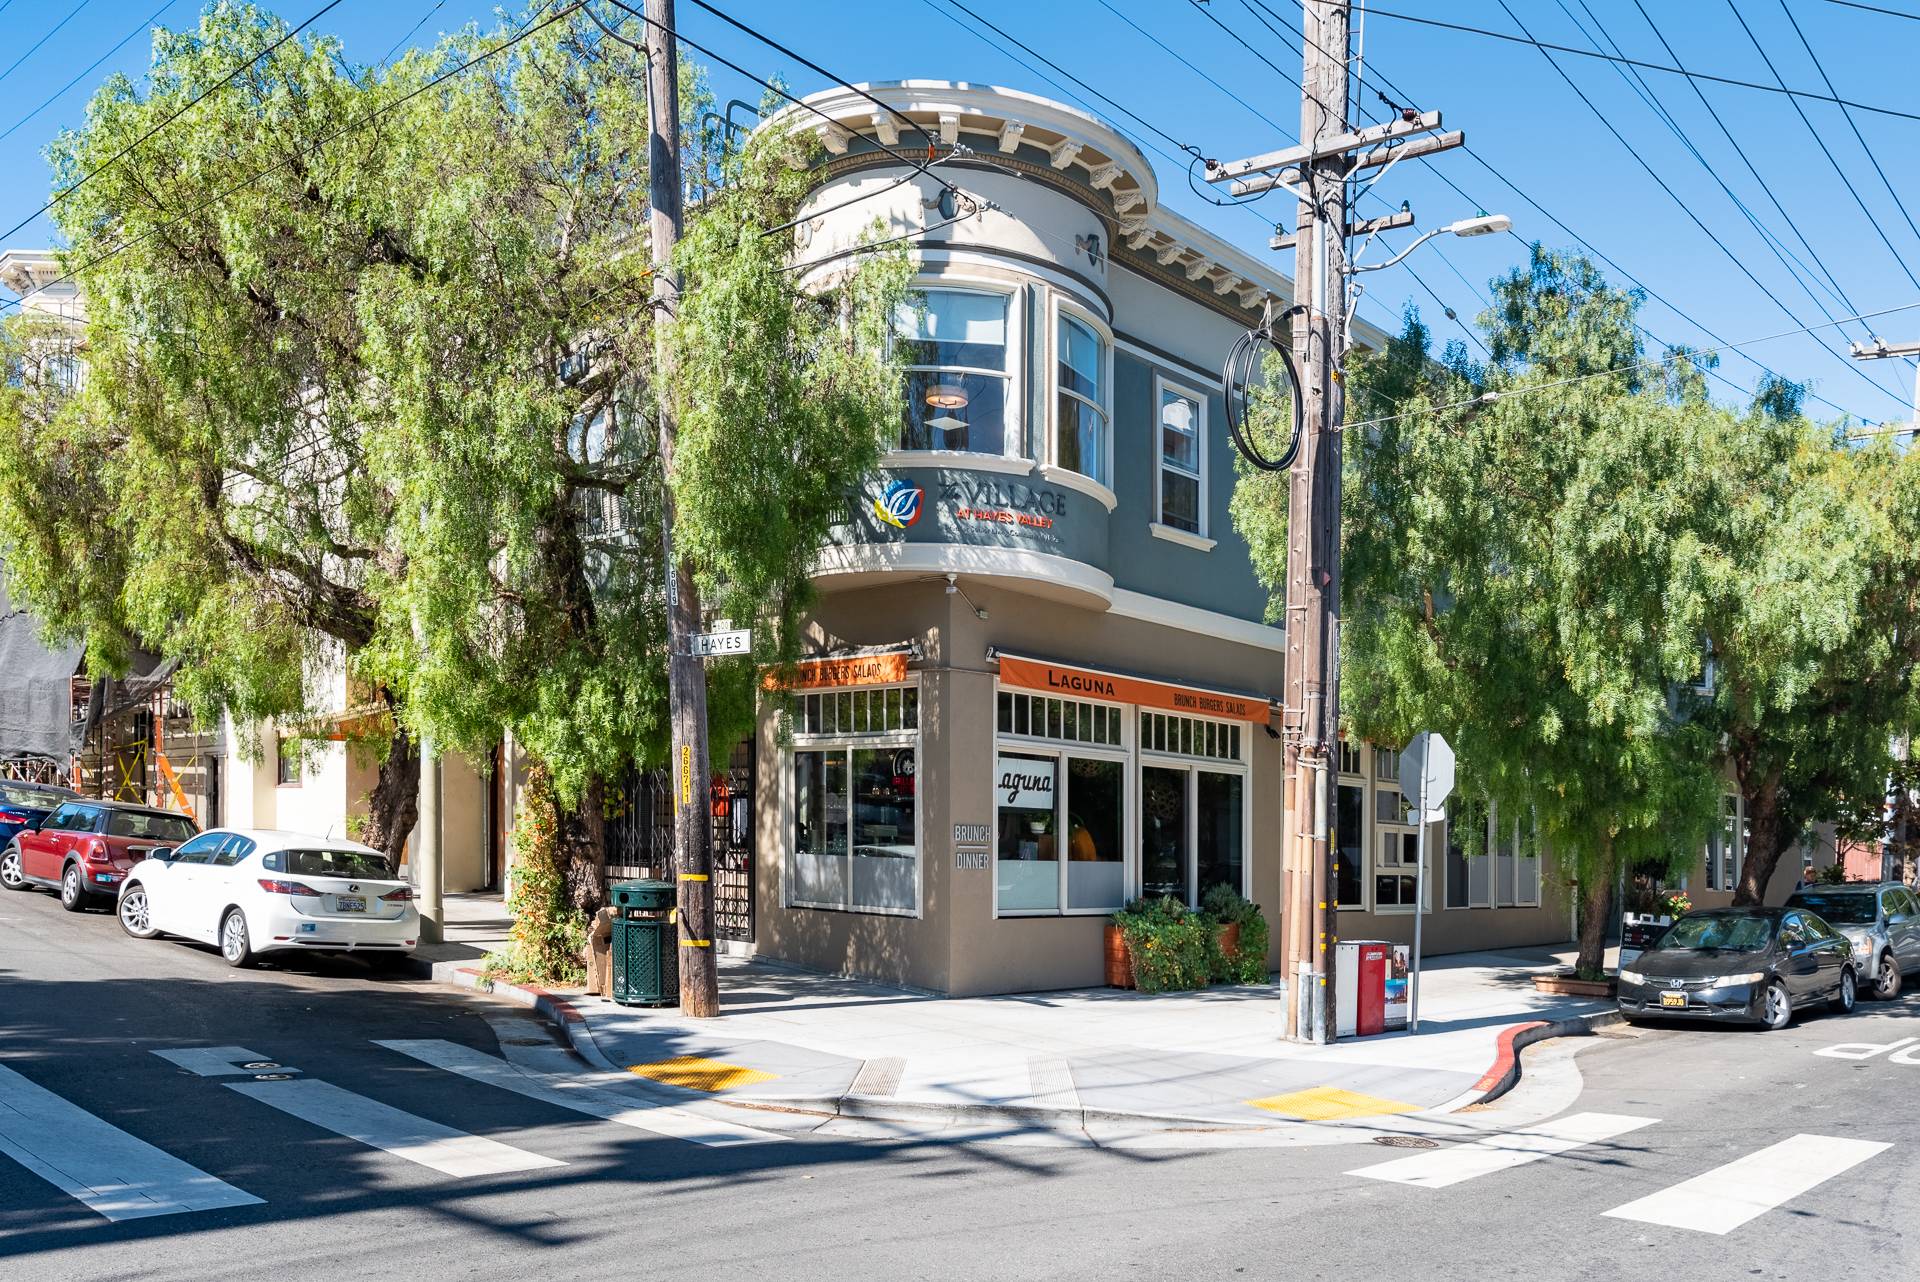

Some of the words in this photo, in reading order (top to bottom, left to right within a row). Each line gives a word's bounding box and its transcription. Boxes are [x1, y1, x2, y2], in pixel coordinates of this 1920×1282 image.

[962, 482, 1066, 517] VILLAGE
[957, 508, 971, 520] AT
[974, 510, 1012, 523] HAYES
[1014, 512, 1053, 529] VALLEY
[701, 636, 741, 651] HAYES
[819, 665, 850, 681] BURGERS
[853, 663, 881, 679] SALADS
[1048, 670, 1115, 696] LAGUNA
[1174, 693, 1197, 708] BRUNCH
[1199, 697, 1223, 712] BURGERS
[1226, 701, 1246, 716] SALADS
[998, 772, 1052, 804] aguna
[954, 825, 990, 842] BRUNCH
[956, 853, 989, 869] DINNER
